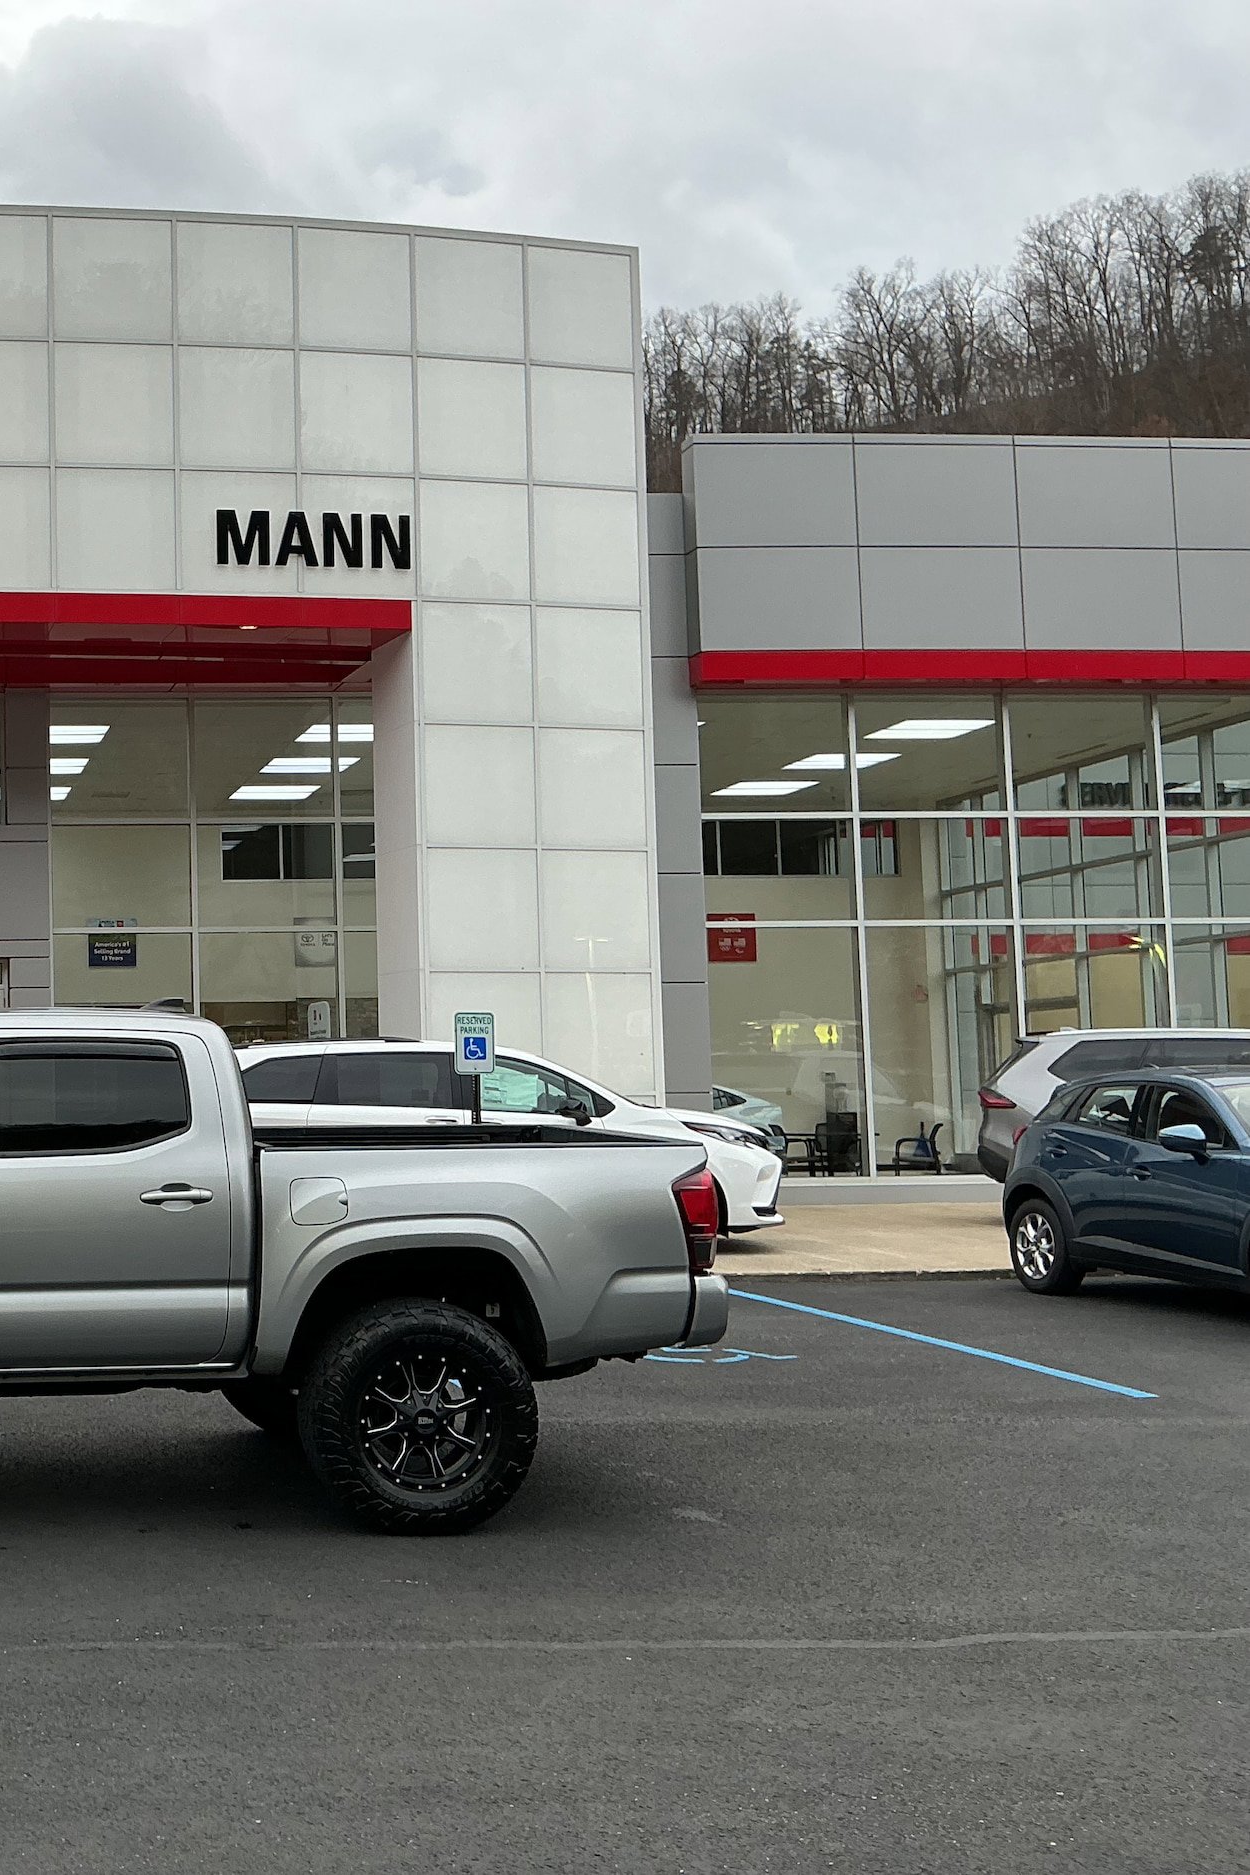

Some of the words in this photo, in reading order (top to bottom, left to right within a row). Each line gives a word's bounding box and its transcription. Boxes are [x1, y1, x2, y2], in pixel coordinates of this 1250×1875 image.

[216, 509, 411, 570] MANN
[457, 1016, 492, 1025] RESERVED
[460, 1026, 489, 1035] PARKING
